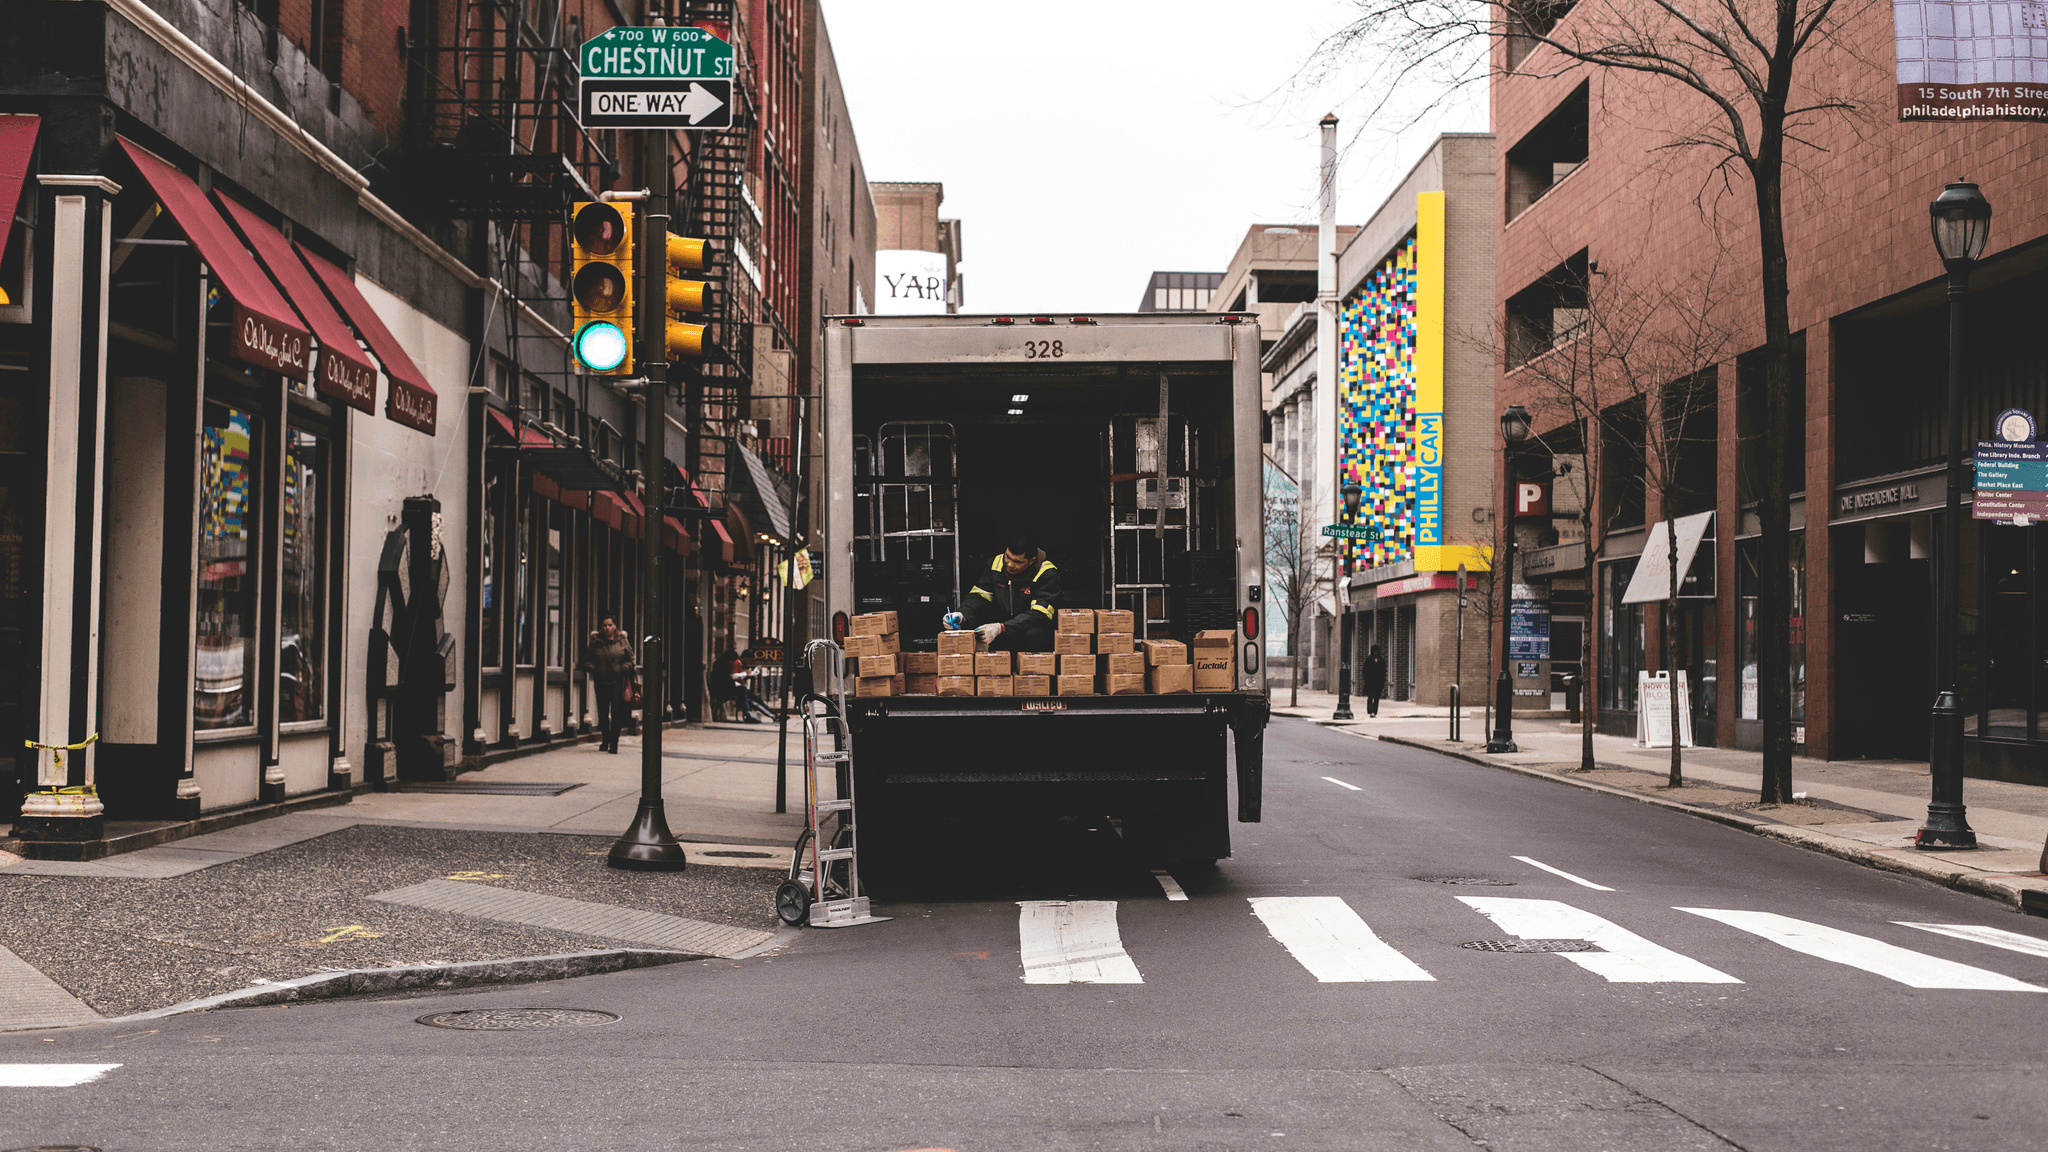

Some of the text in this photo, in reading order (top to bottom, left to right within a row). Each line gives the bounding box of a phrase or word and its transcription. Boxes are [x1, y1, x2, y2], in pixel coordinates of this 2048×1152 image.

[619, 29, 699, 43] 700 W 600
[588, 47, 732, 75] CHESTNUT ST
[598, 94, 687, 112] ONE WAY
[1919, 88, 1934, 99] 15
[1940, 88, 1982, 100] South
[1986, 87, 2010, 99] 7th
[1903, 104, 2048, 118] philadelphiahistory.
[883, 272, 947, 301] YAR
[244, 317, 258, 350] Old
[258, 324, 279, 360] Nelson
[1024, 340, 1064, 359] 328
[327, 355, 338, 382] Old
[339, 360, 353, 392] Nelson
[1519, 484, 1542, 512] P
[1841, 495, 1853, 511] ONE
[1854, 487, 1899, 508] INDEPENDENCE
[1323, 527, 1379, 540] Ranstead St
[1197, 662, 1227, 670] Lactaid
